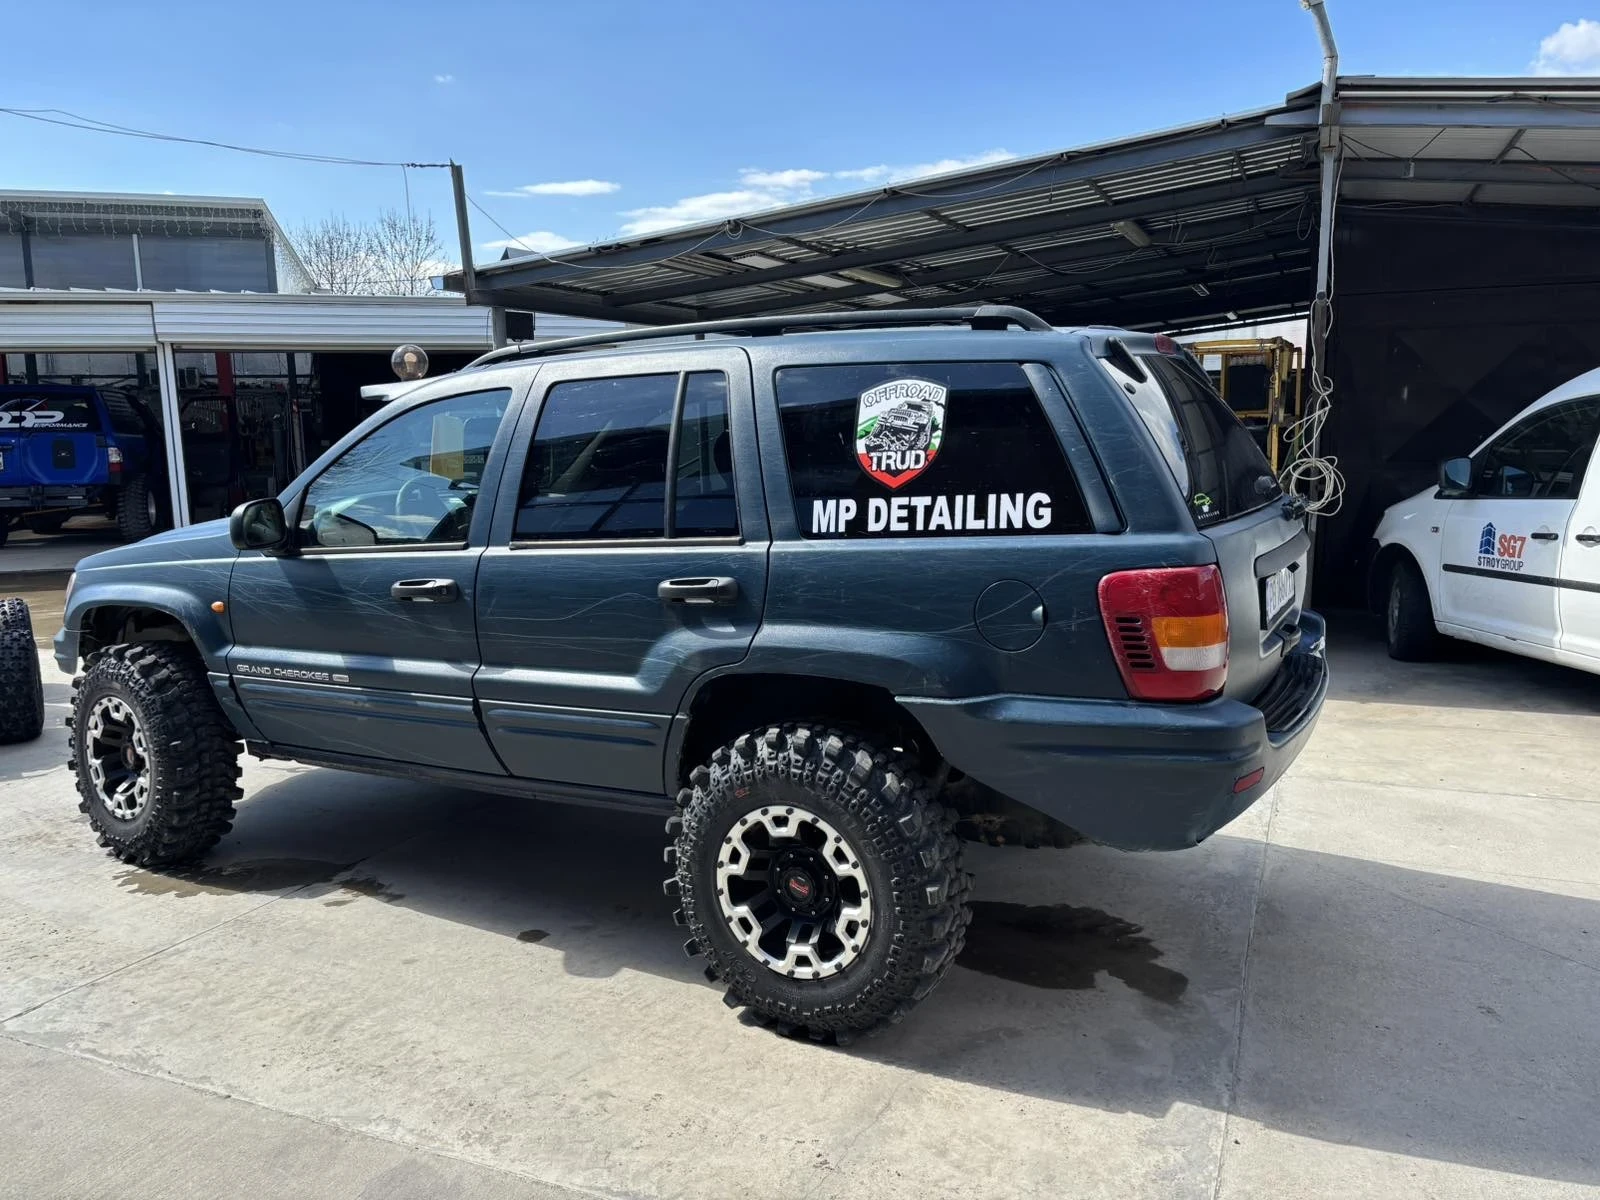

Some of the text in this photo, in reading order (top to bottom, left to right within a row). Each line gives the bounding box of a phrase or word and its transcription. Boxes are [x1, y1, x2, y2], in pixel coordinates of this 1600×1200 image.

[864, 383, 944, 408] OFFROAD
[869, 450, 926, 472] TRUD
[812, 492, 1052, 533] MP DETAILING
[1497, 534, 1526, 558] SG7
[236, 664, 271, 675] GRAND
[273, 668, 329, 681] CHEROKEE
